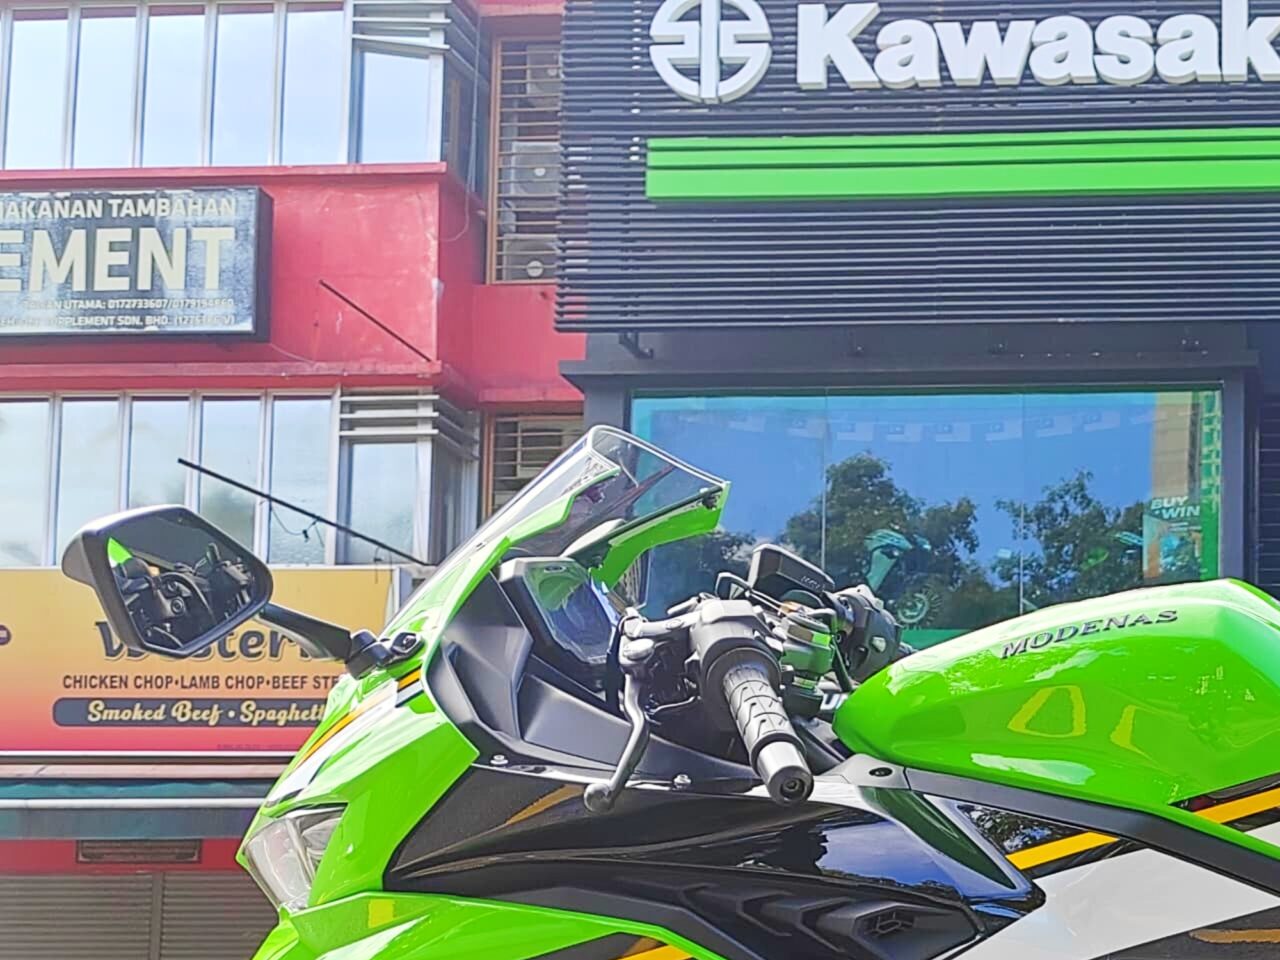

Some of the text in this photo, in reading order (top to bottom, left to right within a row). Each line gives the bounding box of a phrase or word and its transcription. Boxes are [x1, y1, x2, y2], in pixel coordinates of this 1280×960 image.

[108, 197, 236, 218] TAMBAHAN
[64, 299, 106, 310] UTAMA:
[1151, 496, 1188, 510] BUY
[1162, 505, 1201, 519] WIN
[1001, 610, 1179, 659] MODENAS
[63, 675, 128, 690] CHICKEN
[87, 700, 167, 723] Smoked
[171, 700, 224, 726] Beef
